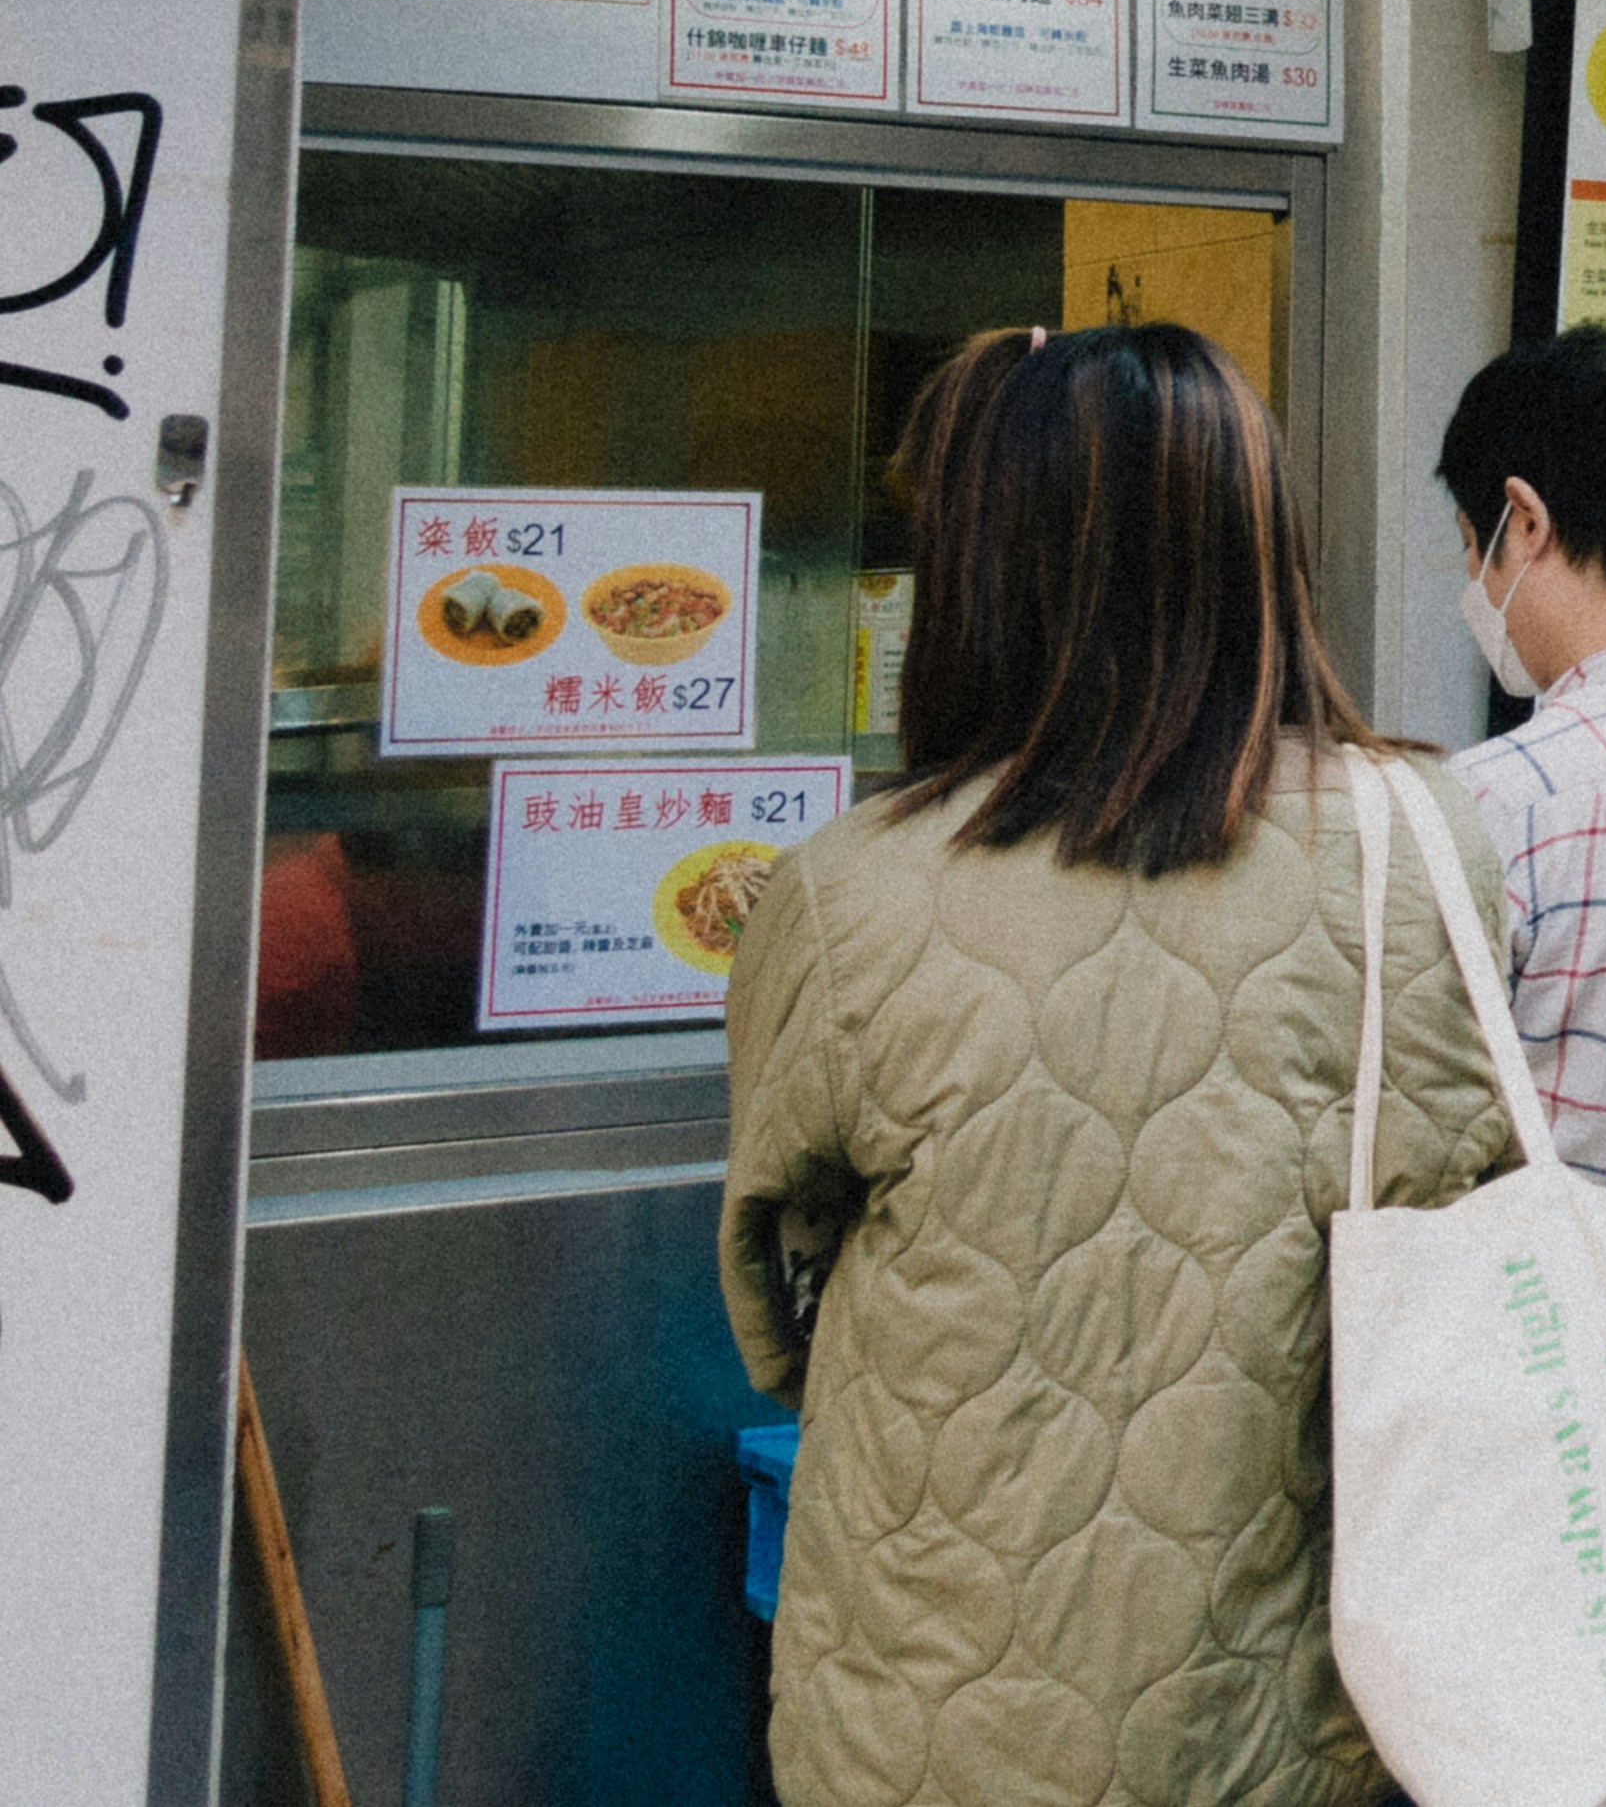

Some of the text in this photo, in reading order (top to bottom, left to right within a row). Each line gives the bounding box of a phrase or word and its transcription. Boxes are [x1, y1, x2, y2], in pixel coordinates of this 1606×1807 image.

[686, 27, 829, 57] 什錦咖喱車仔麵
[1167, 56, 1318, 88] 生菜魚肉湯 $30
[414, 515, 565, 558] 粢飯 $21
[543, 673, 735, 715] 糯米飯 $27
[521, 788, 806, 833] 豉油皇炒麵 $21
[1501, 1258, 1567, 1375] light
[1548, 1387, 1606, 1576] always
